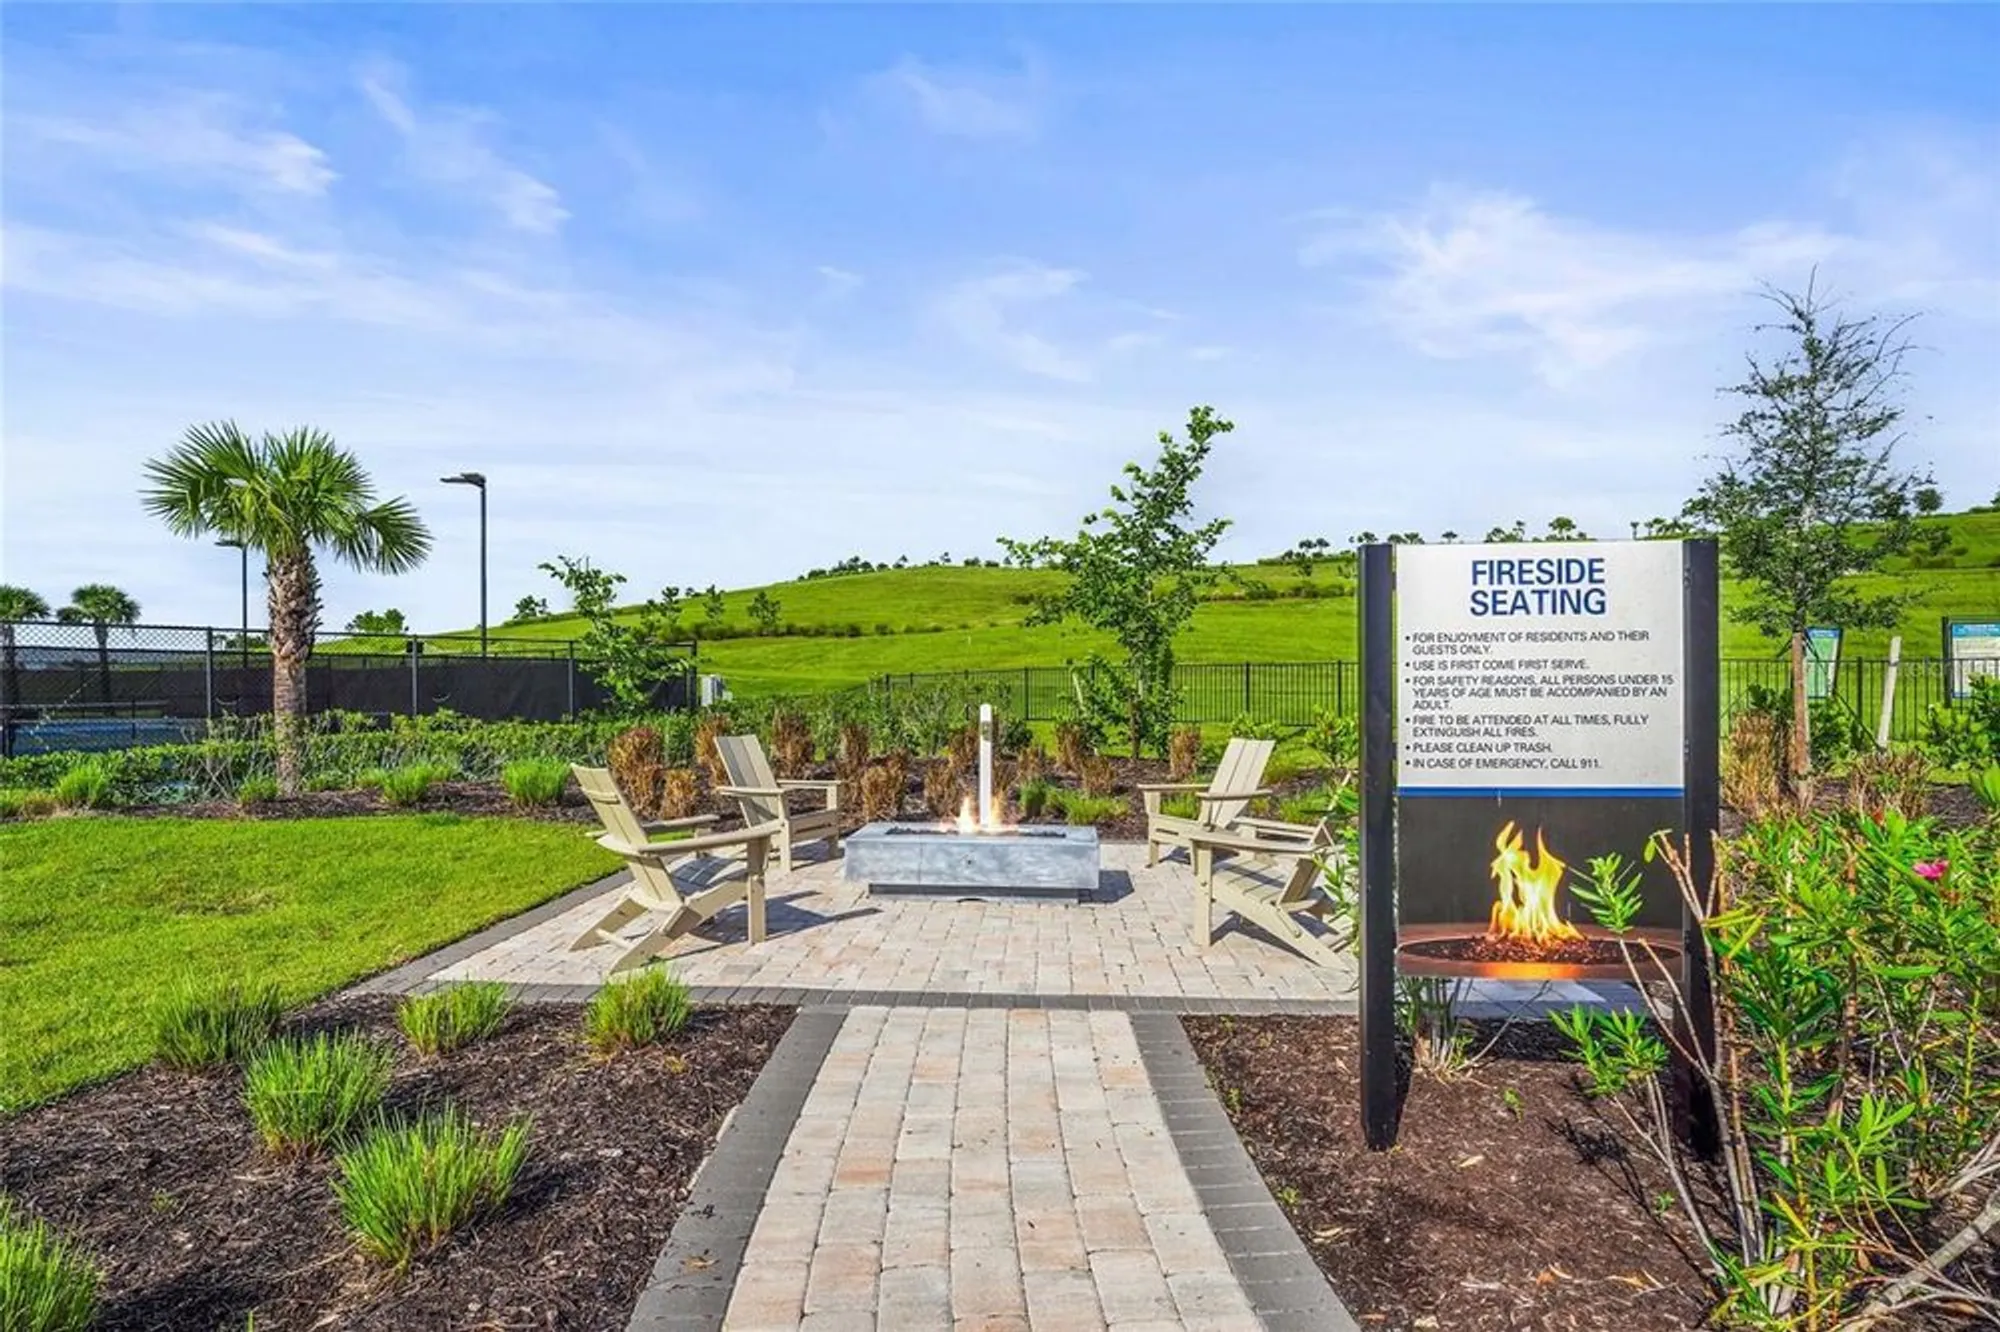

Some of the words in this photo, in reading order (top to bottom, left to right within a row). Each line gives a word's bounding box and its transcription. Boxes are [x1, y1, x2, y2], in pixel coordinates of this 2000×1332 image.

[1472, 558, 1605, 586] FIRESIDE
[1470, 588, 1606, 616] SEATING
[1413, 633, 1434, 642] FOR
[1438, 632, 1506, 642] ENJOYMENT
[1508, 632, 1523, 642] OF
[1526, 632, 1587, 642] RESIDENTS
[1589, 631, 1615, 640] AND
[1618, 631, 1649, 640] THEIR
[1413, 645, 1457, 655] GUESTS
[1413, 660, 1435, 671] USE
[1438, 660, 1448, 670] IS
[1451, 660, 1480, 670] FIRST
[1483, 660, 1516, 670] COME
[1518, 660, 1548, 670] FIRST
[1413, 676, 1434, 686] FOR
[1438, 676, 1479, 686] SAFETY
[1540, 675, 1560, 685] ALL
[1562, 675, 1616, 685] PERSONS
[1618, 674, 1658, 685] UNDER
[1413, 688, 1449, 698] YEARS
[1452, 688, 1466, 698] OF
[1468, 688, 1492, 698] AGE
[1495, 688, 1528, 698] MUST
[1530, 688, 1544, 697] BE
[1546, 687, 1630, 697] ACCOMPANIED
[1633, 687, 1648, 696] BY
[1650, 686, 1666, 696] AN
[1413, 715, 1434, 725] FIRE
[1438, 715, 1453, 725] TO
[1456, 715, 1470, 725] BE
[1472, 715, 1530, 725] ATTENDED
[1533, 715, 1548, 725] AT
[1550, 715, 1572, 725] ALL
[1614, 714, 1648, 724] FULLY
[1413, 727, 1480, 737] EXTINGUISH
[1483, 727, 1503, 737] ALL
[1413, 742, 1454, 752] PLEASE
[1456, 742, 1493, 752] CLEAN
[1496, 742, 1511, 752] UP
[1413, 758, 1425, 768] IN
[1427, 758, 1456, 768] CASE
[1459, 758, 1474, 768] OF
[1551, 758, 1578, 768] CALL
